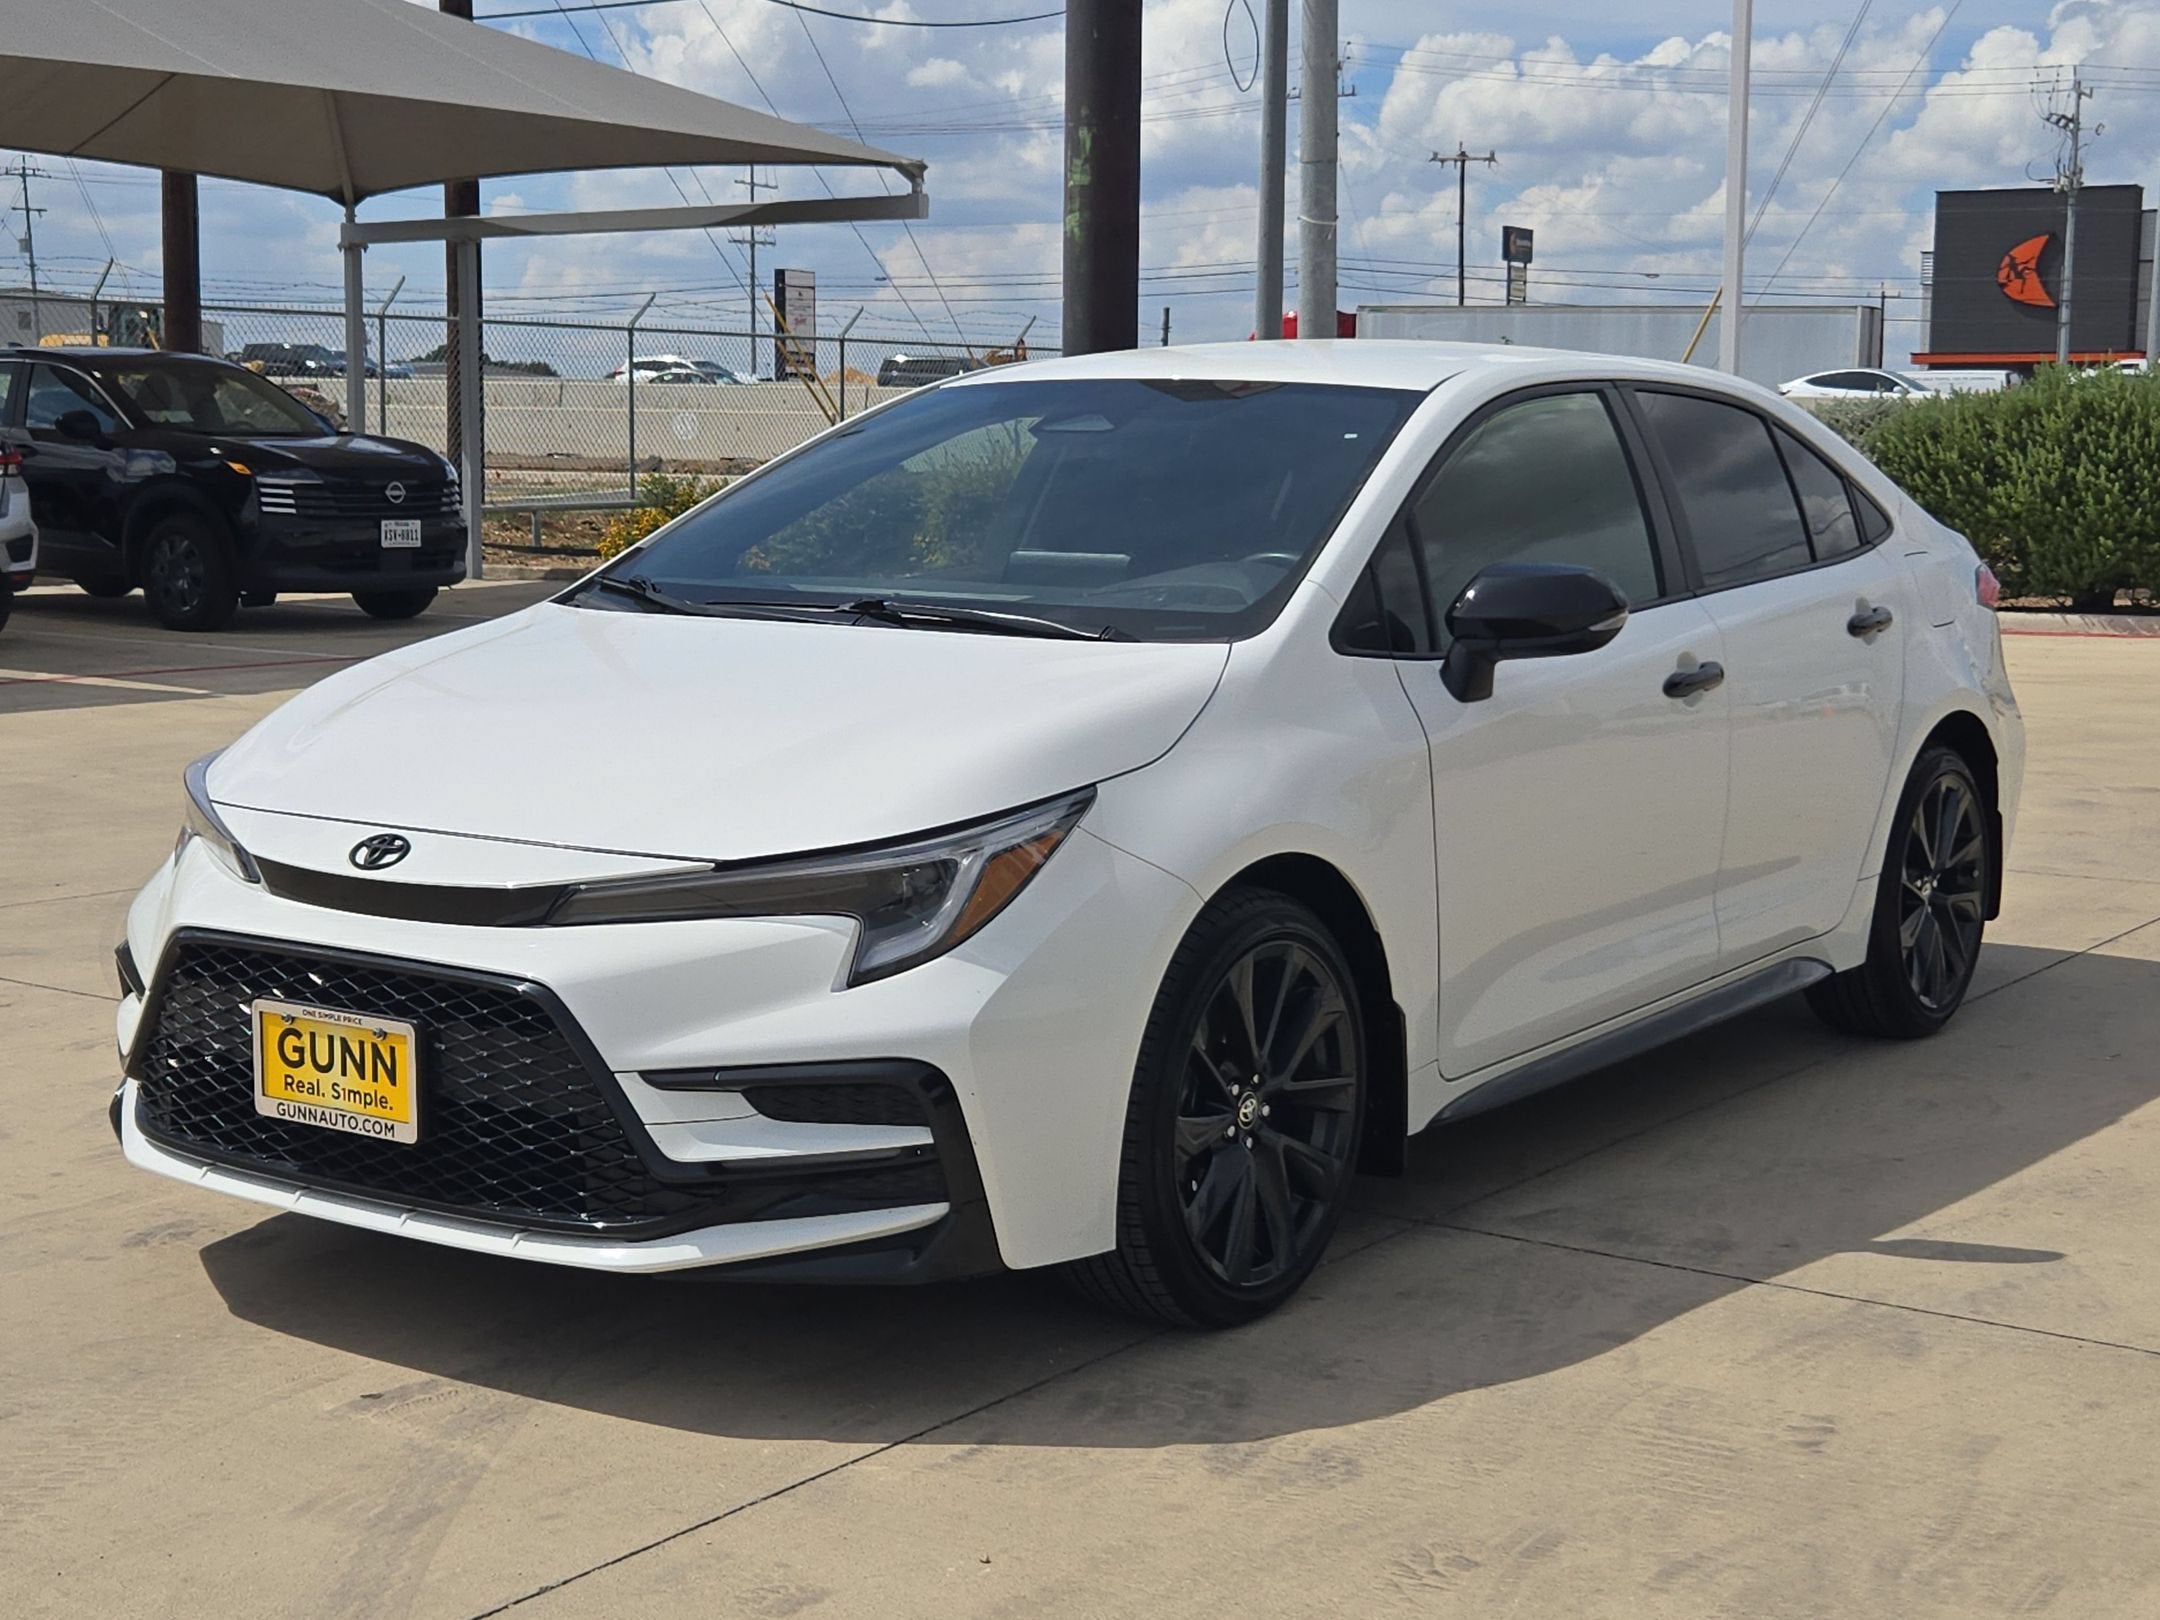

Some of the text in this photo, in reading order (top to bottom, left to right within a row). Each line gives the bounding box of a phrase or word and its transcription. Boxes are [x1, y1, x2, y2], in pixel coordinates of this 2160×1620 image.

[302, 1009, 362, 1025] ONE SIMPLE PRICE
[277, 1027, 397, 1087] GUNN
[284, 1074, 325, 1098] Real.
[276, 1102, 395, 1138] GUNNAUTO.COM
